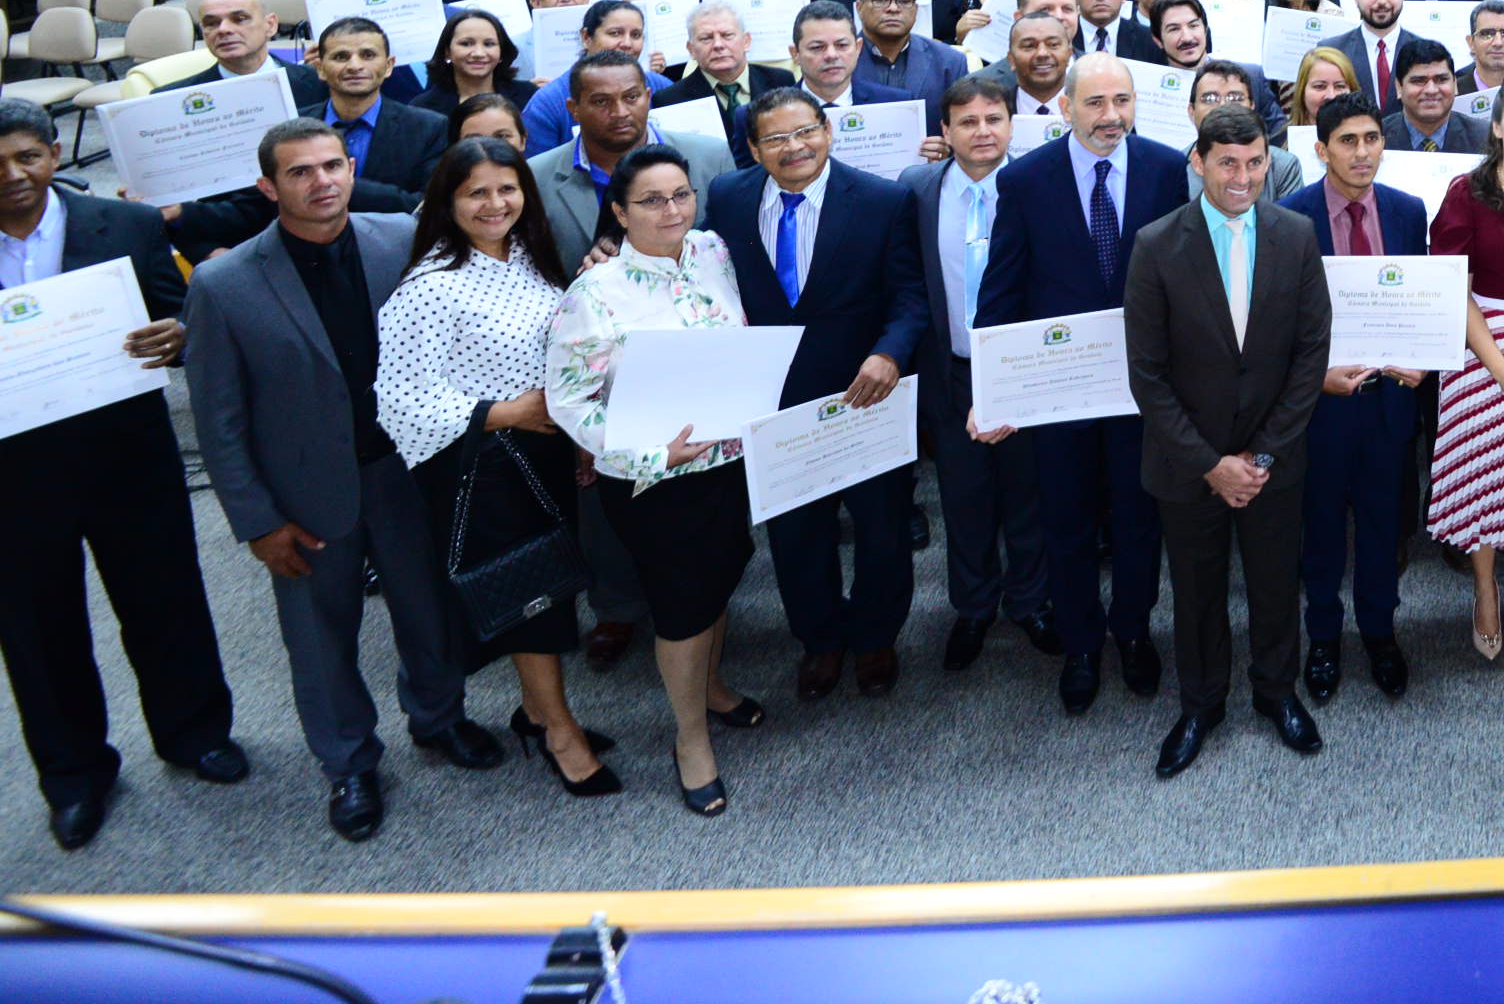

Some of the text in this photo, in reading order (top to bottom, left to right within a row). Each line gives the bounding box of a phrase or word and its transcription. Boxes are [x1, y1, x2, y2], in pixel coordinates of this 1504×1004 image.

[139, 124, 177, 139] Diploma
[192, 114, 221, 127] Honra
[236, 106, 265, 118] Mérito
[844, 135, 866, 143] Honra
[879, 132, 903, 140] Mérito
[1338, 289, 1369, 299] Diploma
[1381, 289, 1405, 299] Honra
[1416, 289, 1442, 299] Mérito
[1371, 300, 1400, 308] Municipal
[1000, 354, 1035, 365] Diploma
[1047, 346, 1073, 356] Honra
[1086, 341, 1113, 351] Mérito
[775, 433, 809, 449] Diploma
[823, 418, 849, 431] Honra
[862, 405, 889, 417] Mérito
